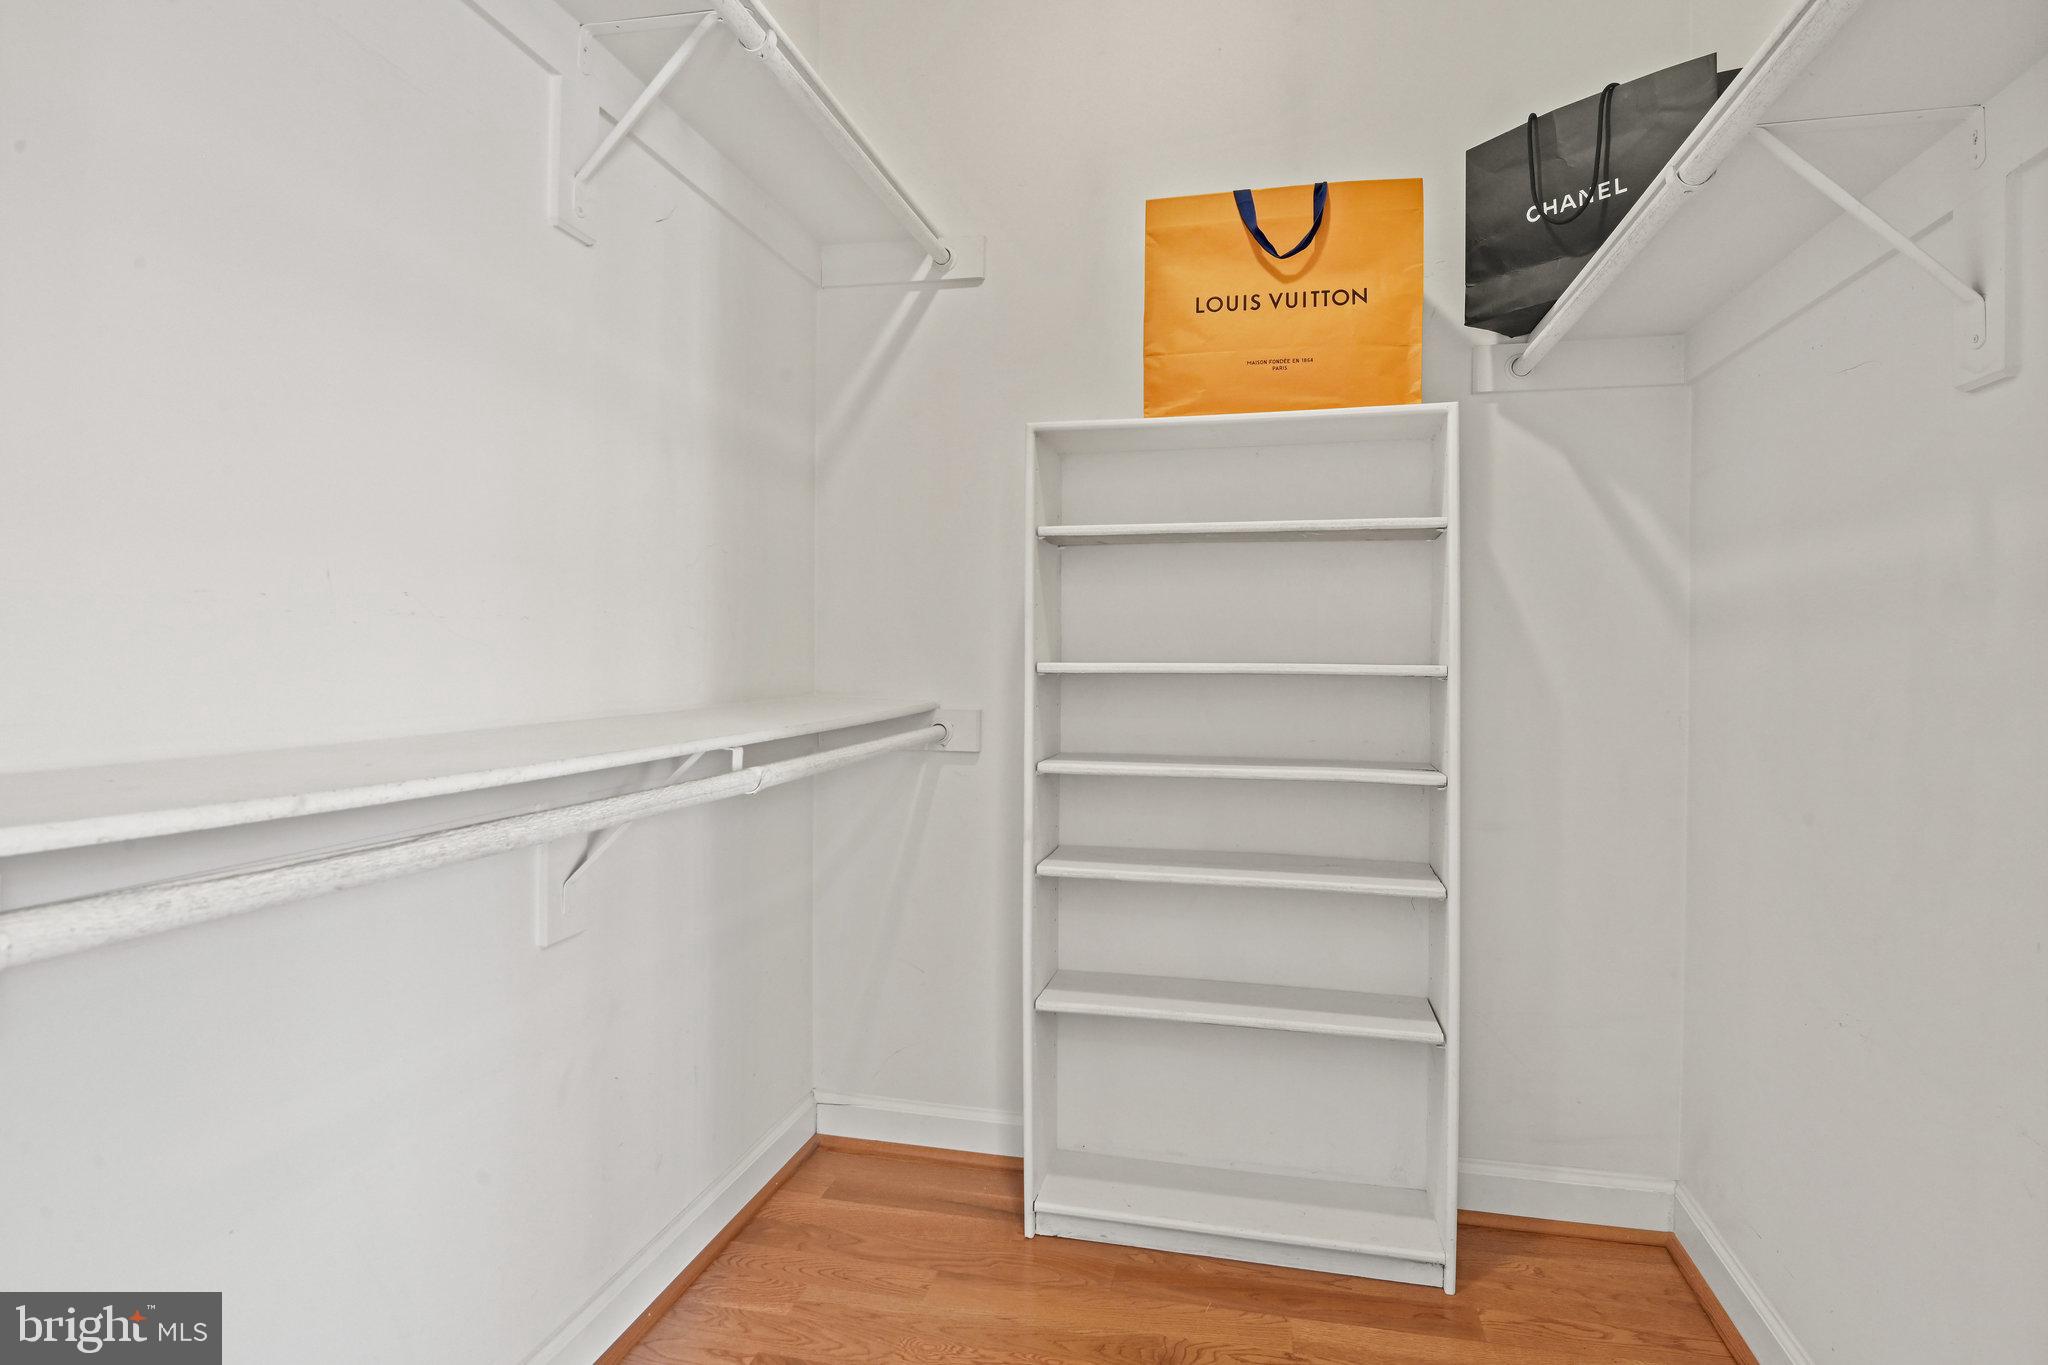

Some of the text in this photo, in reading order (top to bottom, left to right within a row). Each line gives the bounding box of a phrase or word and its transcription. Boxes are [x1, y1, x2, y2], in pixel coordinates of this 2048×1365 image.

[1526, 178, 1628, 222] CHANEL
[1195, 287, 1368, 313] LOUIS VUITTON
